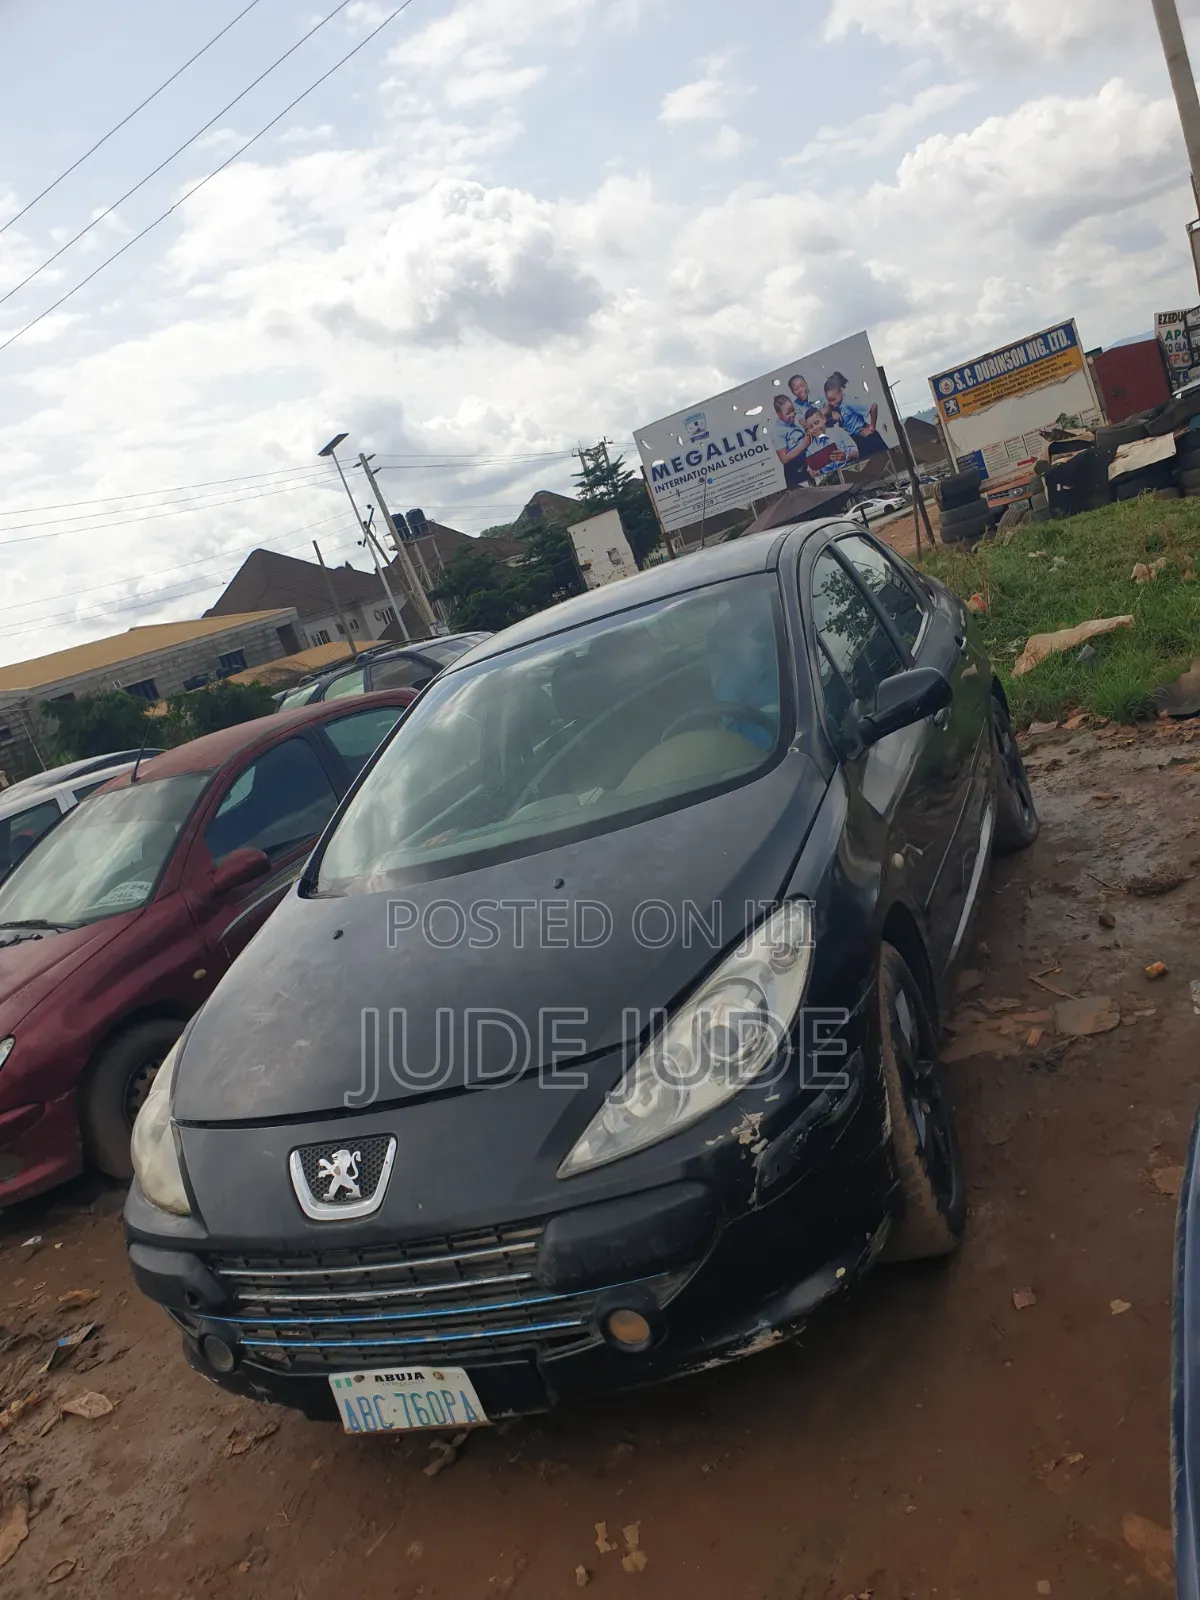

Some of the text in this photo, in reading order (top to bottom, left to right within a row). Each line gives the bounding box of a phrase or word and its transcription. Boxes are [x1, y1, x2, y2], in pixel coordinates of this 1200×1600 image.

[954, 373, 966, 390] S.
[963, 367, 977, 386] C.
[974, 345, 1028, 381] DUBINSON
[1025, 337, 1049, 360] NIG.
[1047, 328, 1071, 351] LTD.
[1175, 341, 1188, 353] GLA
[654, 459, 727, 494] INTERNATIONAL
[729, 443, 769, 464] SCHOOL
[374, 1372, 425, 1382] ABUJA
